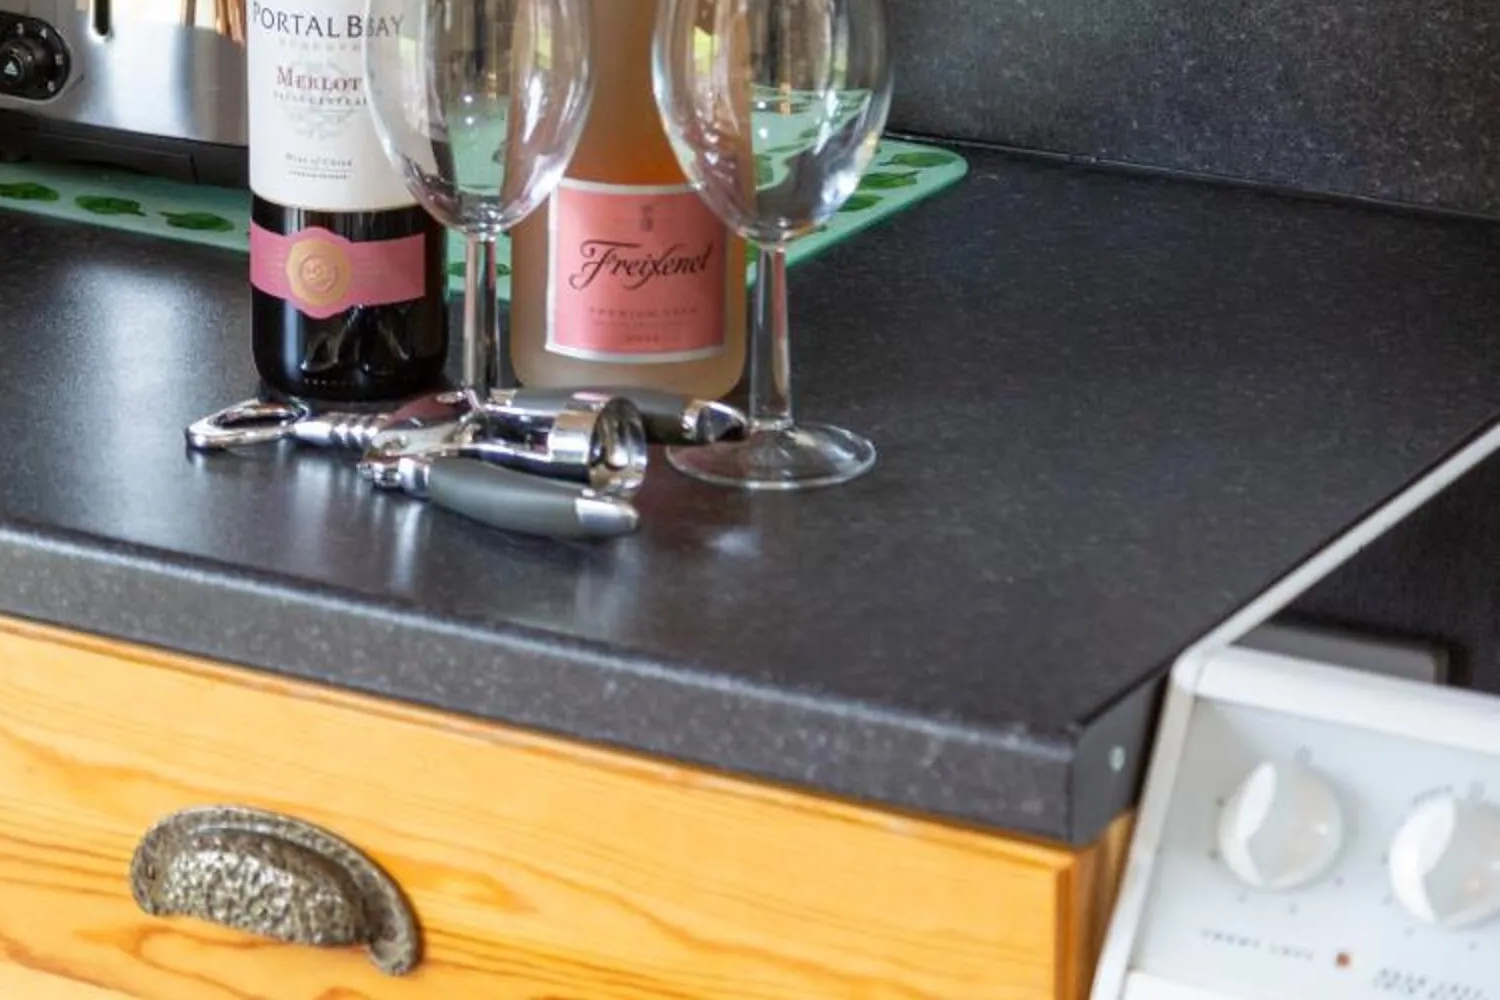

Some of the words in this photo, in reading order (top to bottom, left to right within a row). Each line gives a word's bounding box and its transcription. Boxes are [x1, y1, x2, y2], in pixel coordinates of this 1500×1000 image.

[252, 0, 341, 38] PORTAL
[277, 65, 362, 92] MERLOT
[569, 239, 715, 291] Freixenet
